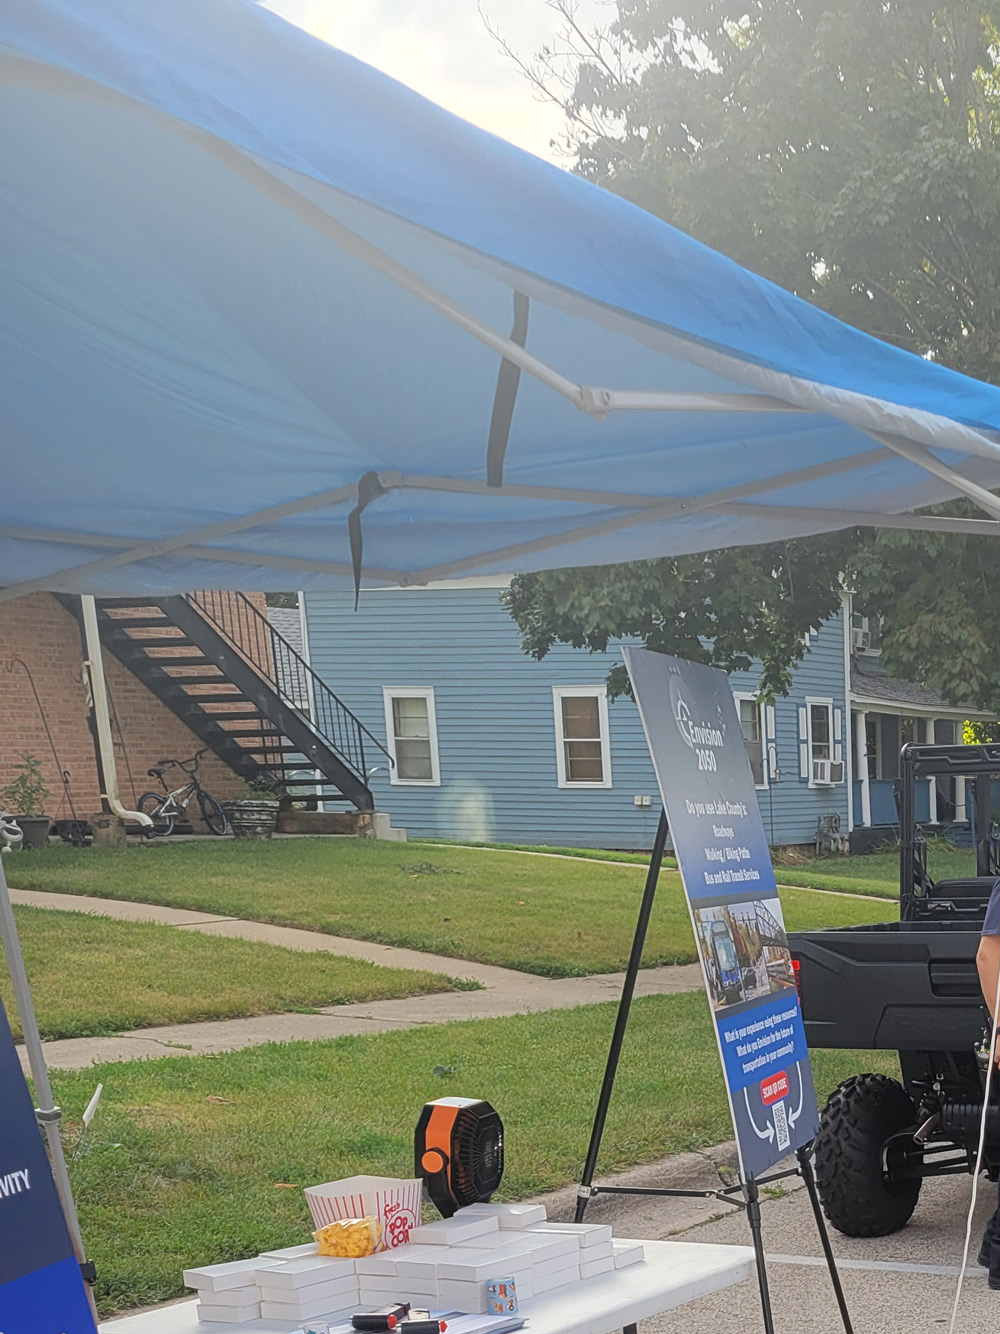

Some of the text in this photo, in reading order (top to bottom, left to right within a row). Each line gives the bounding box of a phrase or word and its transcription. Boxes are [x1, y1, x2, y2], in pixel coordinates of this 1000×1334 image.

[688, 720, 723, 746] Envision
[695, 748, 717, 772] 2050
[686, 799, 695, 814] Do
[695, 803, 705, 817] you
[705, 803, 715, 814] use
[714, 800, 727, 814] Lake
[713, 825, 734, 840] Roadways
[704, 848, 723, 863] Walking
[726, 847, 740, 862] Biking
[738, 847, 751, 859] Paths
[704, 868, 760, 885] Bus and Rail Transit Services
[762, 1084, 774, 1099] SCAN
[777, 1077, 788, 1091] CODE
[0, 1168, 30, 1198] VITY
[389, 1216, 408, 1236] POP
